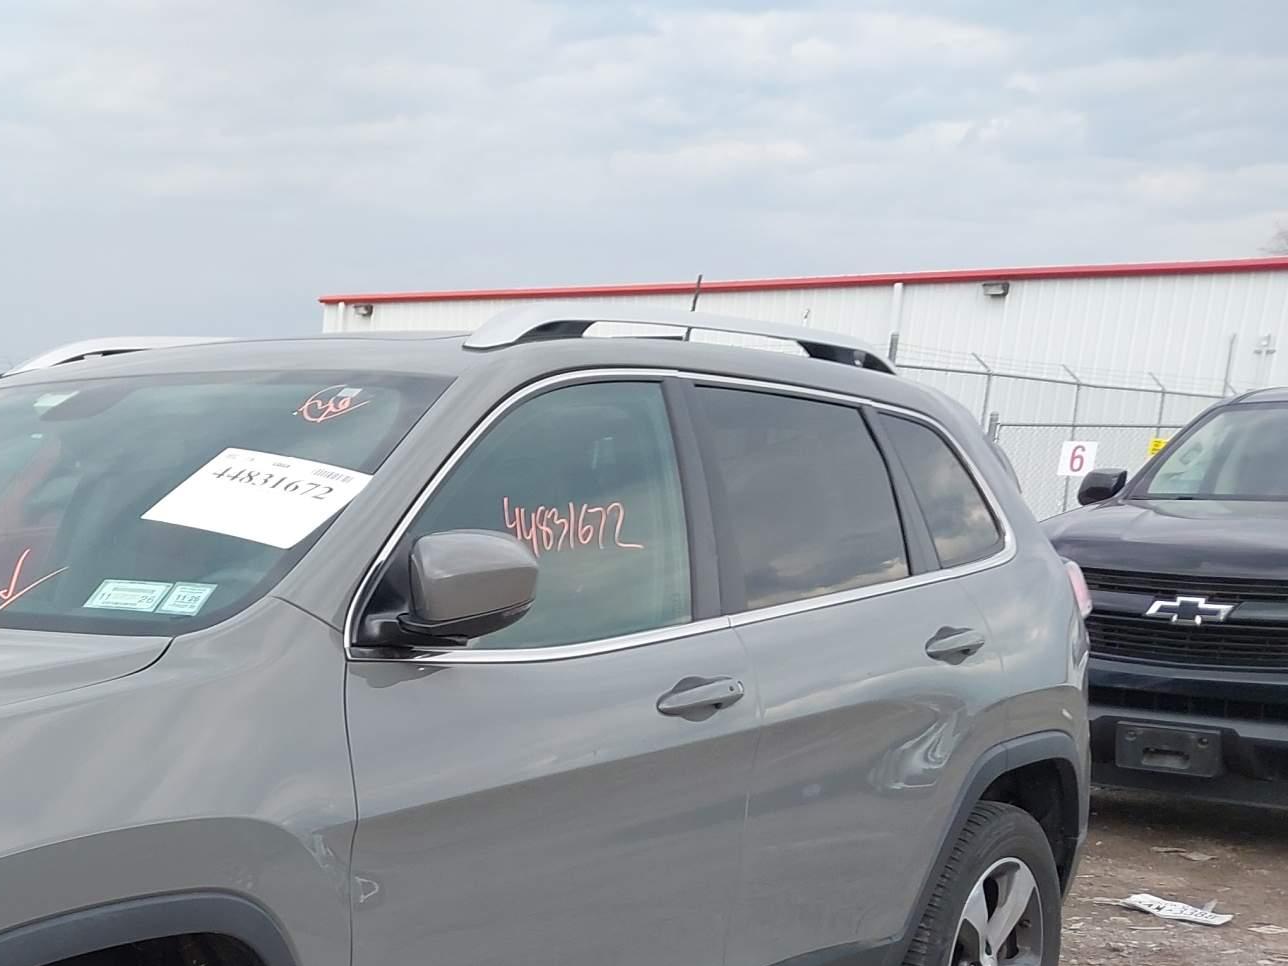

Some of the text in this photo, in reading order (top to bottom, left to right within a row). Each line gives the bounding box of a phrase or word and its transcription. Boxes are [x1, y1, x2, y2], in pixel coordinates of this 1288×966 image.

[1069, 444, 1085, 473] 6
[212, 466, 334, 500] 44831672
[503, 496, 644, 558] 44831672
